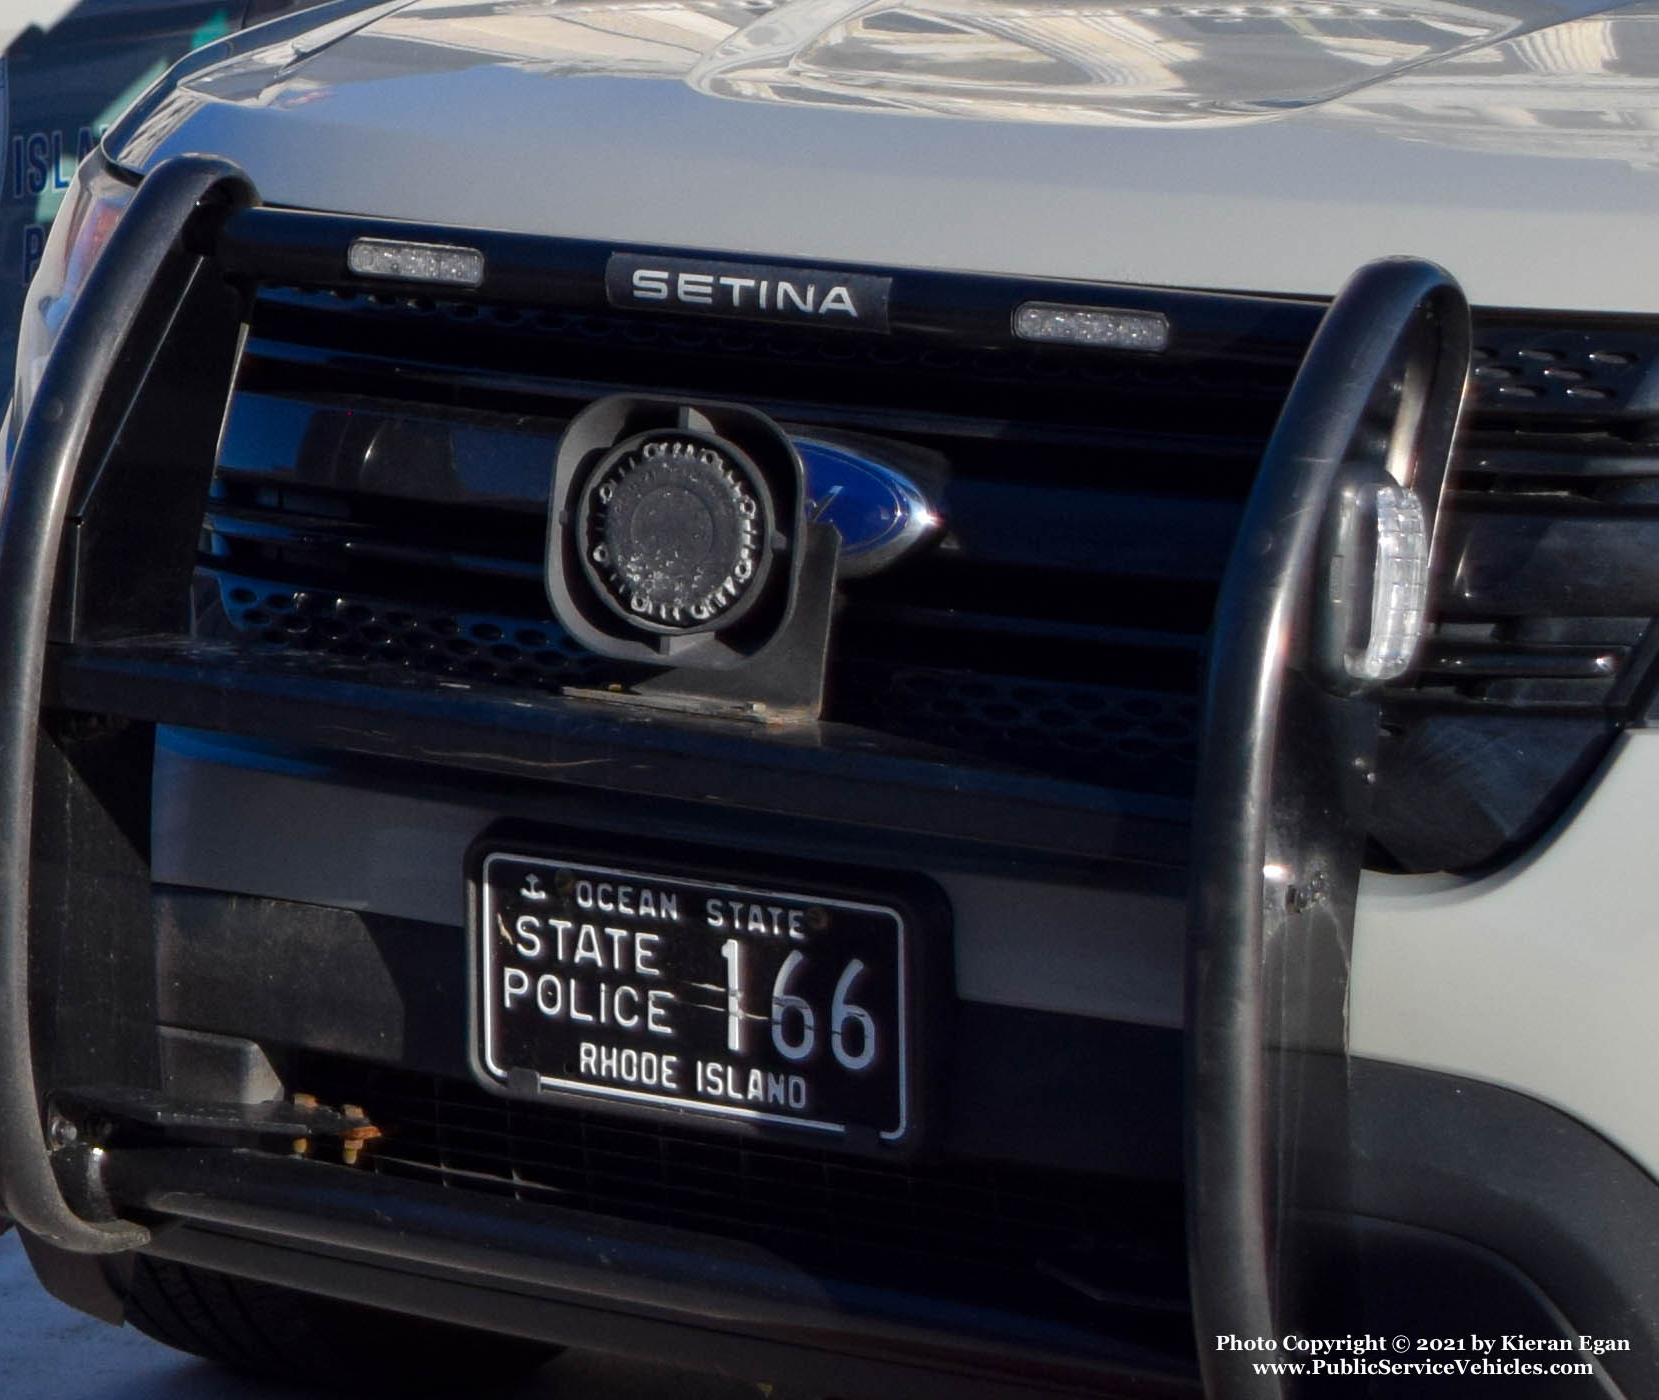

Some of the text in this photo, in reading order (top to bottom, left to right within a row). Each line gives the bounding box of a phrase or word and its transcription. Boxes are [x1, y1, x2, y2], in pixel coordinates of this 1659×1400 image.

[632, 269, 858, 317] SETINA
[575, 880, 806, 940] OCEAN STATE
[515, 915, 661, 976] STATE
[503, 967, 675, 1034] POLICE
[721, 939, 876, 1070] 166
[579, 1042, 807, 1109] RHODE ISLAND
